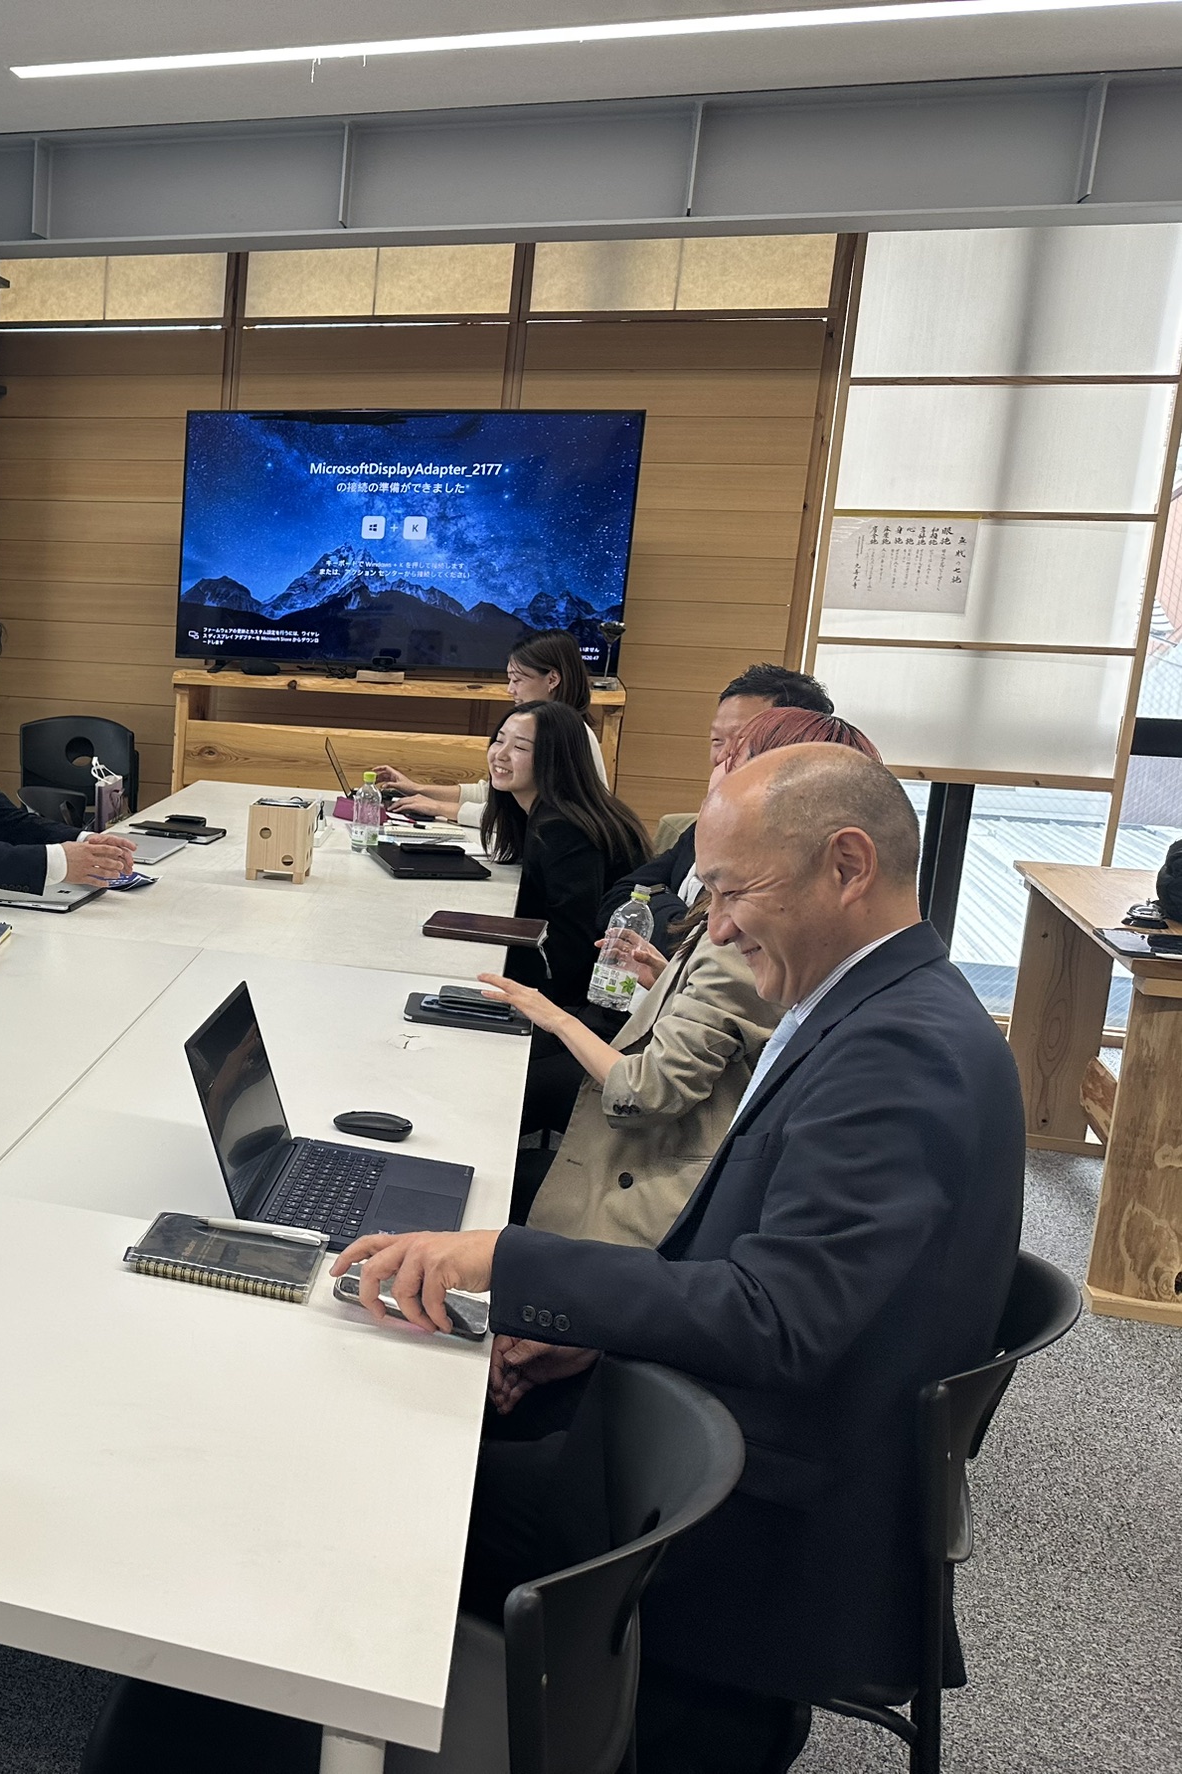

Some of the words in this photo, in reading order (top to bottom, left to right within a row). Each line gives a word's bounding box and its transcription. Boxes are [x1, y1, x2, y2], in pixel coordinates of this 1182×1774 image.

[309, 462, 503, 478] MicrosoftDisplayAdapter_2177
[336, 482, 466, 494] の接続の準備ができました
[412, 524, 419, 533] K
